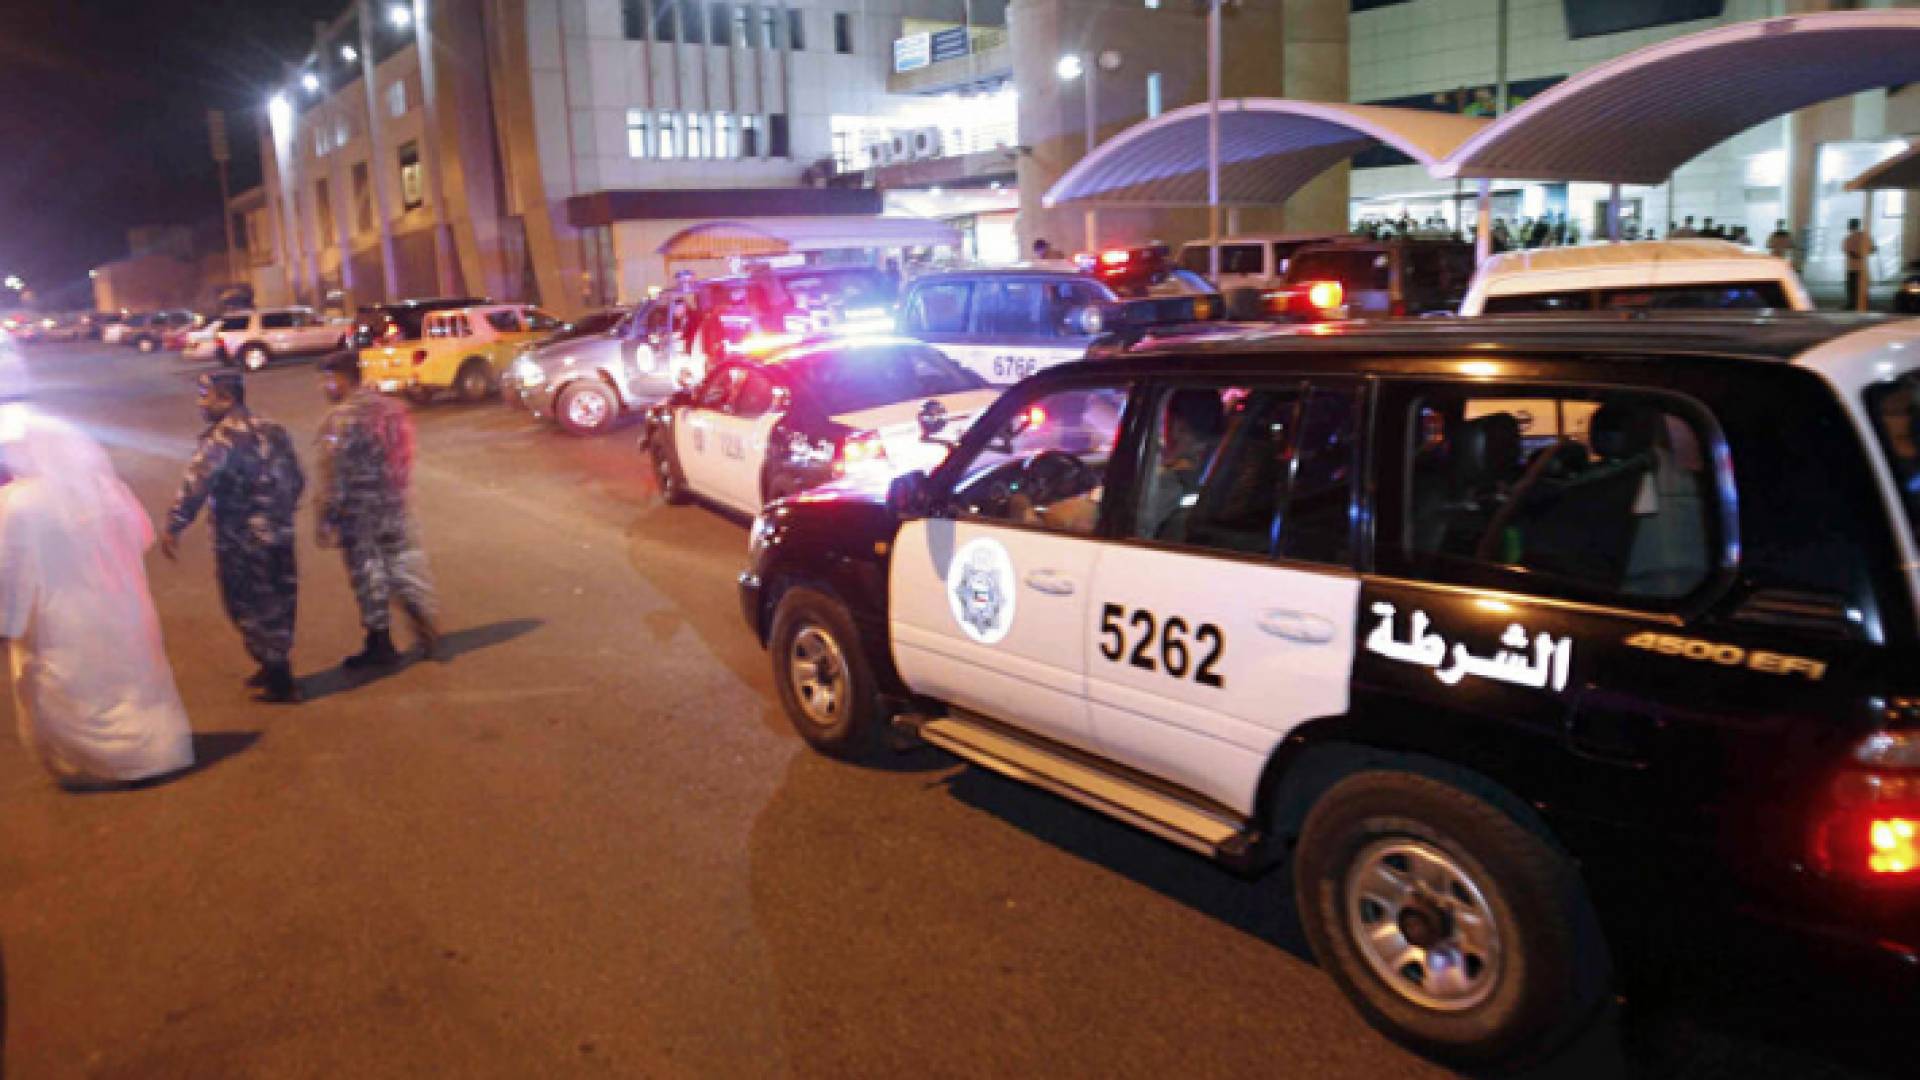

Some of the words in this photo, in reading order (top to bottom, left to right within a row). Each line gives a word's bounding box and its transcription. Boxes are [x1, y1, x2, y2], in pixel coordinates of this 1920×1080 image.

[1100, 602, 1225, 688] 5262
[1366, 602, 1572, 692] الشرطة
[1624, 632, 1745, 665] 4500
[1747, 650, 1826, 680] EFI
